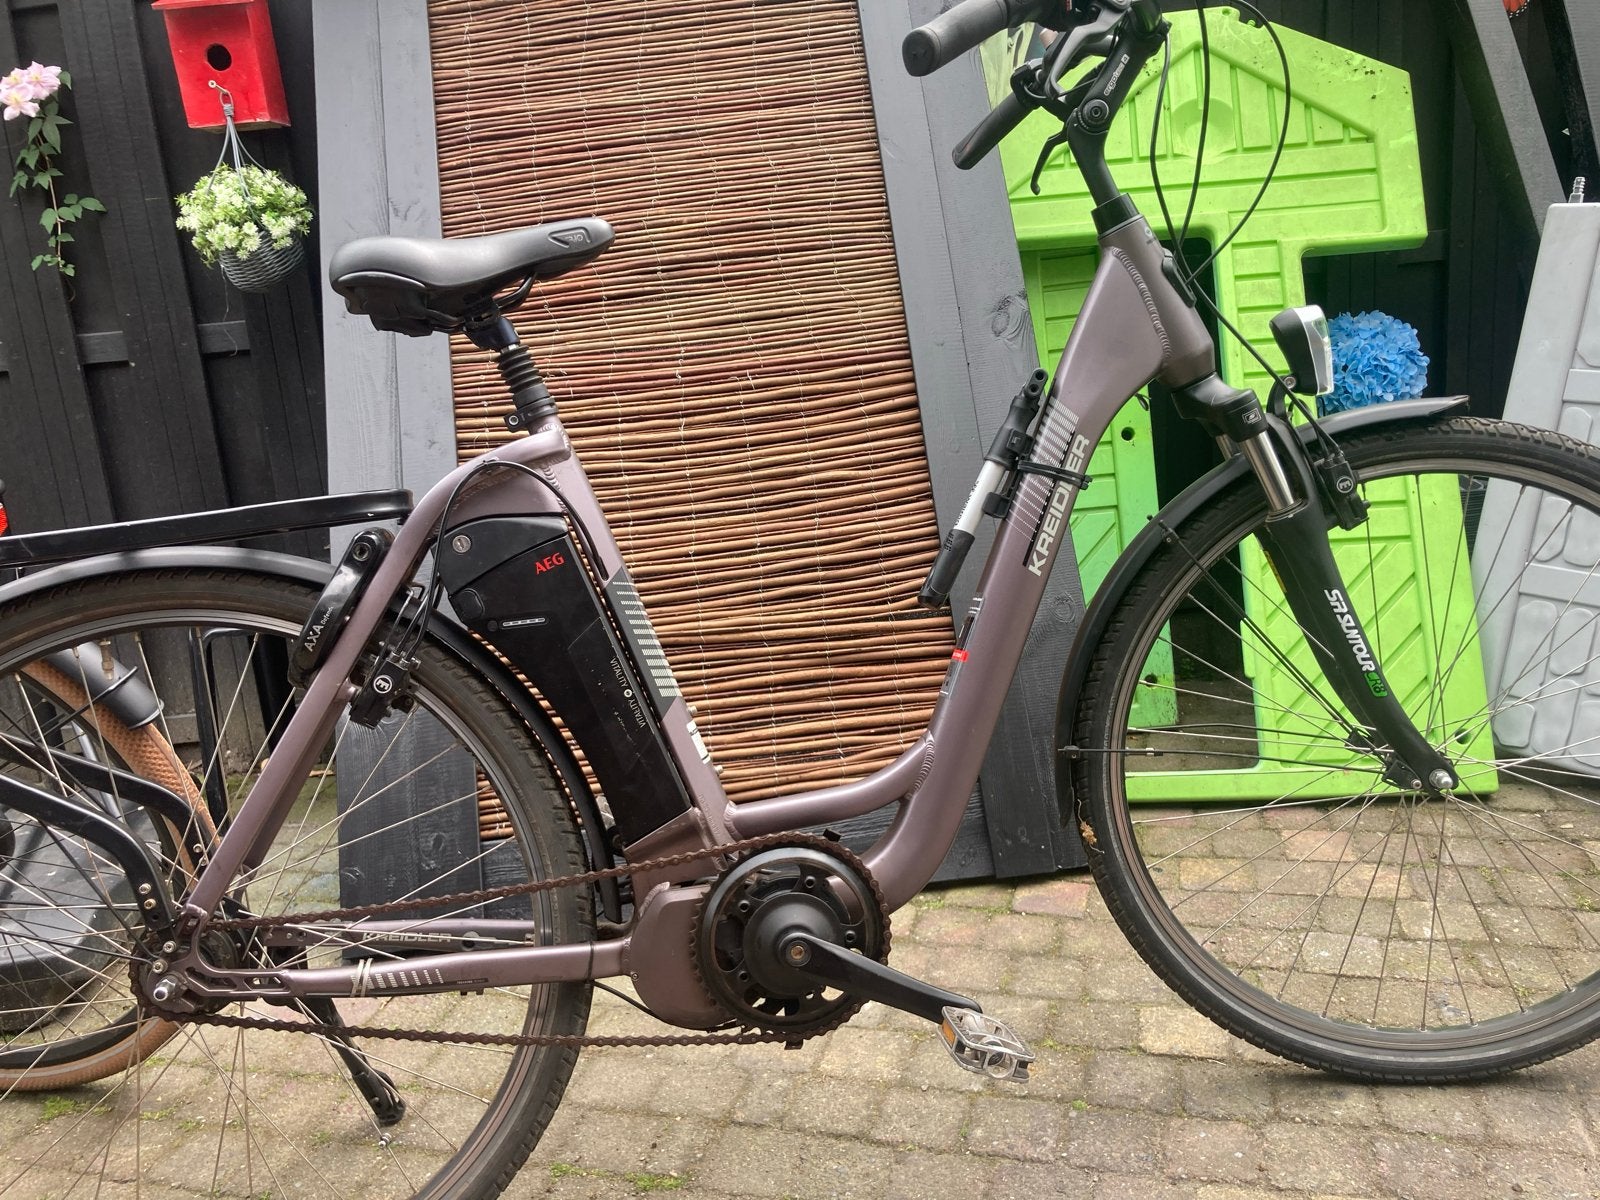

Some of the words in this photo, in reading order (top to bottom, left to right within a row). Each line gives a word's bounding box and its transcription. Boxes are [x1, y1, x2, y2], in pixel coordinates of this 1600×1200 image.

[535, 552, 565, 575] AEG
[304, 624, 324, 652] AXA
[1324, 589, 1348, 613] SR
[1336, 613, 1376, 672] SUNTOUR
[609, 657, 629, 688] VITALITY
[362, 931, 452, 943] KREIDLER
